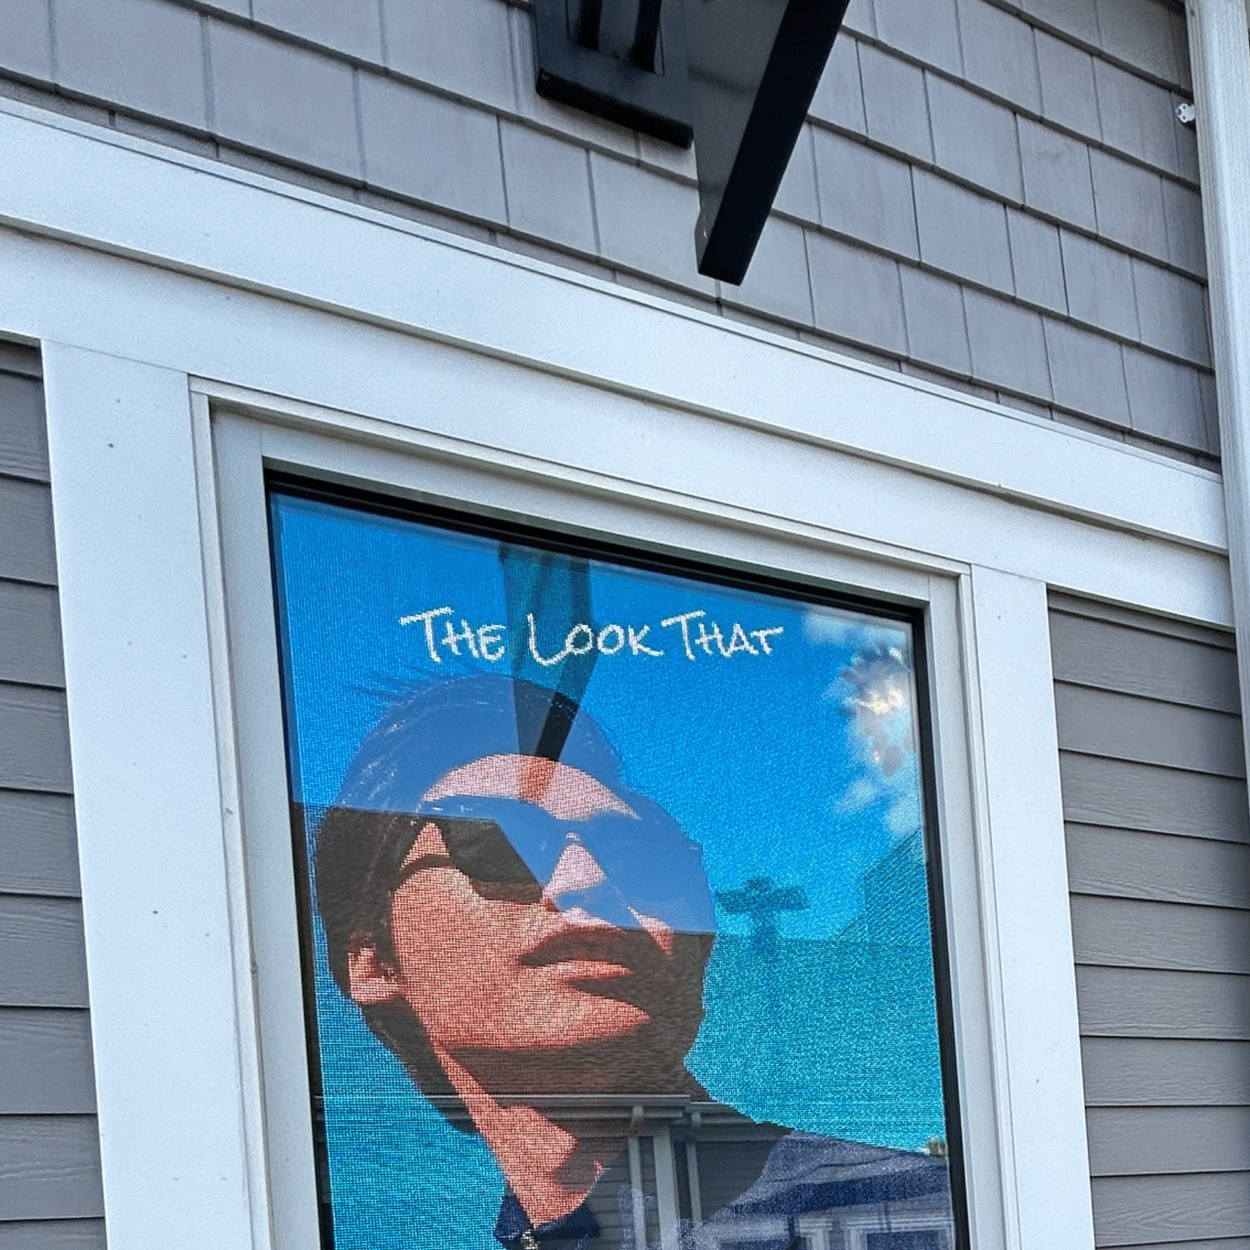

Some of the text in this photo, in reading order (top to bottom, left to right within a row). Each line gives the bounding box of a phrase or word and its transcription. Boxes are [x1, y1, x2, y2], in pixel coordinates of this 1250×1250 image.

[398, 605, 784, 667] THE LOOK THAT
